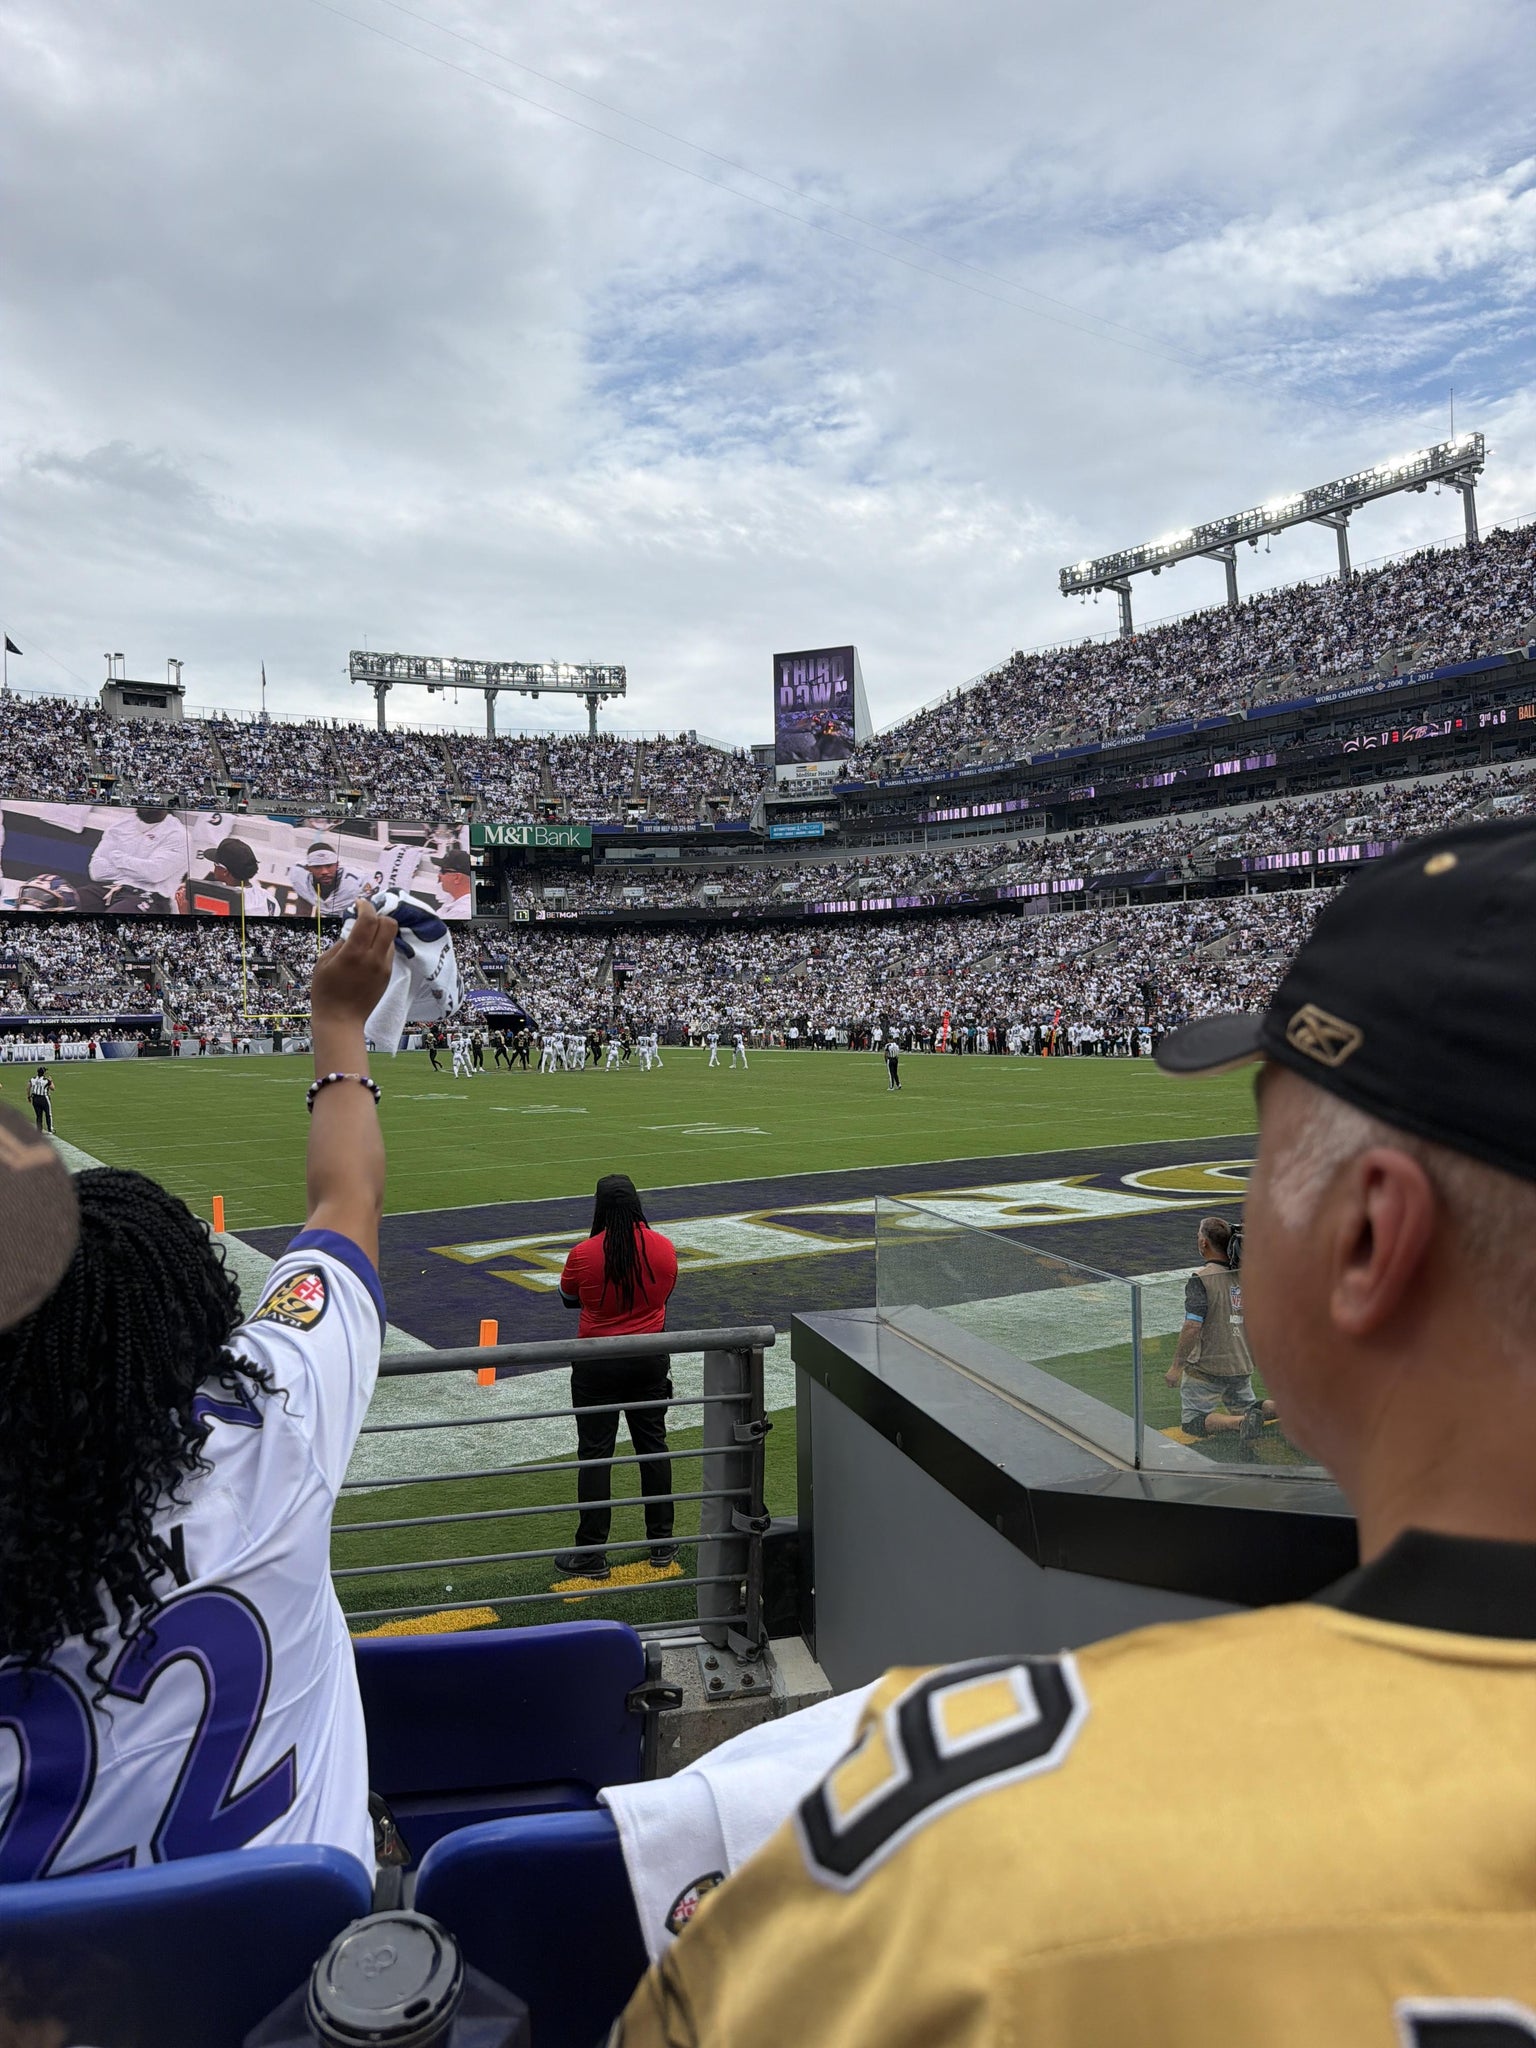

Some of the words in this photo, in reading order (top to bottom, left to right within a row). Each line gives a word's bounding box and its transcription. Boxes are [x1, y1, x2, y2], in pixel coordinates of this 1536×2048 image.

[780, 656, 845, 686] THIRD
[780, 680, 847, 707] DOWN
[1315, 693, 1338, 704] WORLD
[1338, 684, 1374, 699] CHAMPIONS
[1387, 679, 1403, 688] 2000
[1417, 672, 1434, 682] 2012
[1479, 711, 1491, 728] 3rd
[1500, 709, 1506, 724] 6
[1518, 704, 1536, 721] BALL
[1444, 720, 1452, 734] 17
[1101, 737, 1117, 750] RING
[1121, 734, 1146, 746] HONOR
[1381, 732, 1389, 745] 17
[936, 806, 969, 822] THIRD
[972, 802, 1002, 817] DOWN
[483, 825, 533, 845] M&T
[535, 826, 580, 846] Bank
[1266, 850, 1310, 870] THIRD
[1317, 844, 1360, 864] DOWN
[1016, 882, 1048, 897] THIRD
[546, 911, 577, 919] BETMGM
[823, 901, 856, 914] THIRD
[861, 898, 892, 911] DOWN
[0, 1584, 297, 1883] 22
